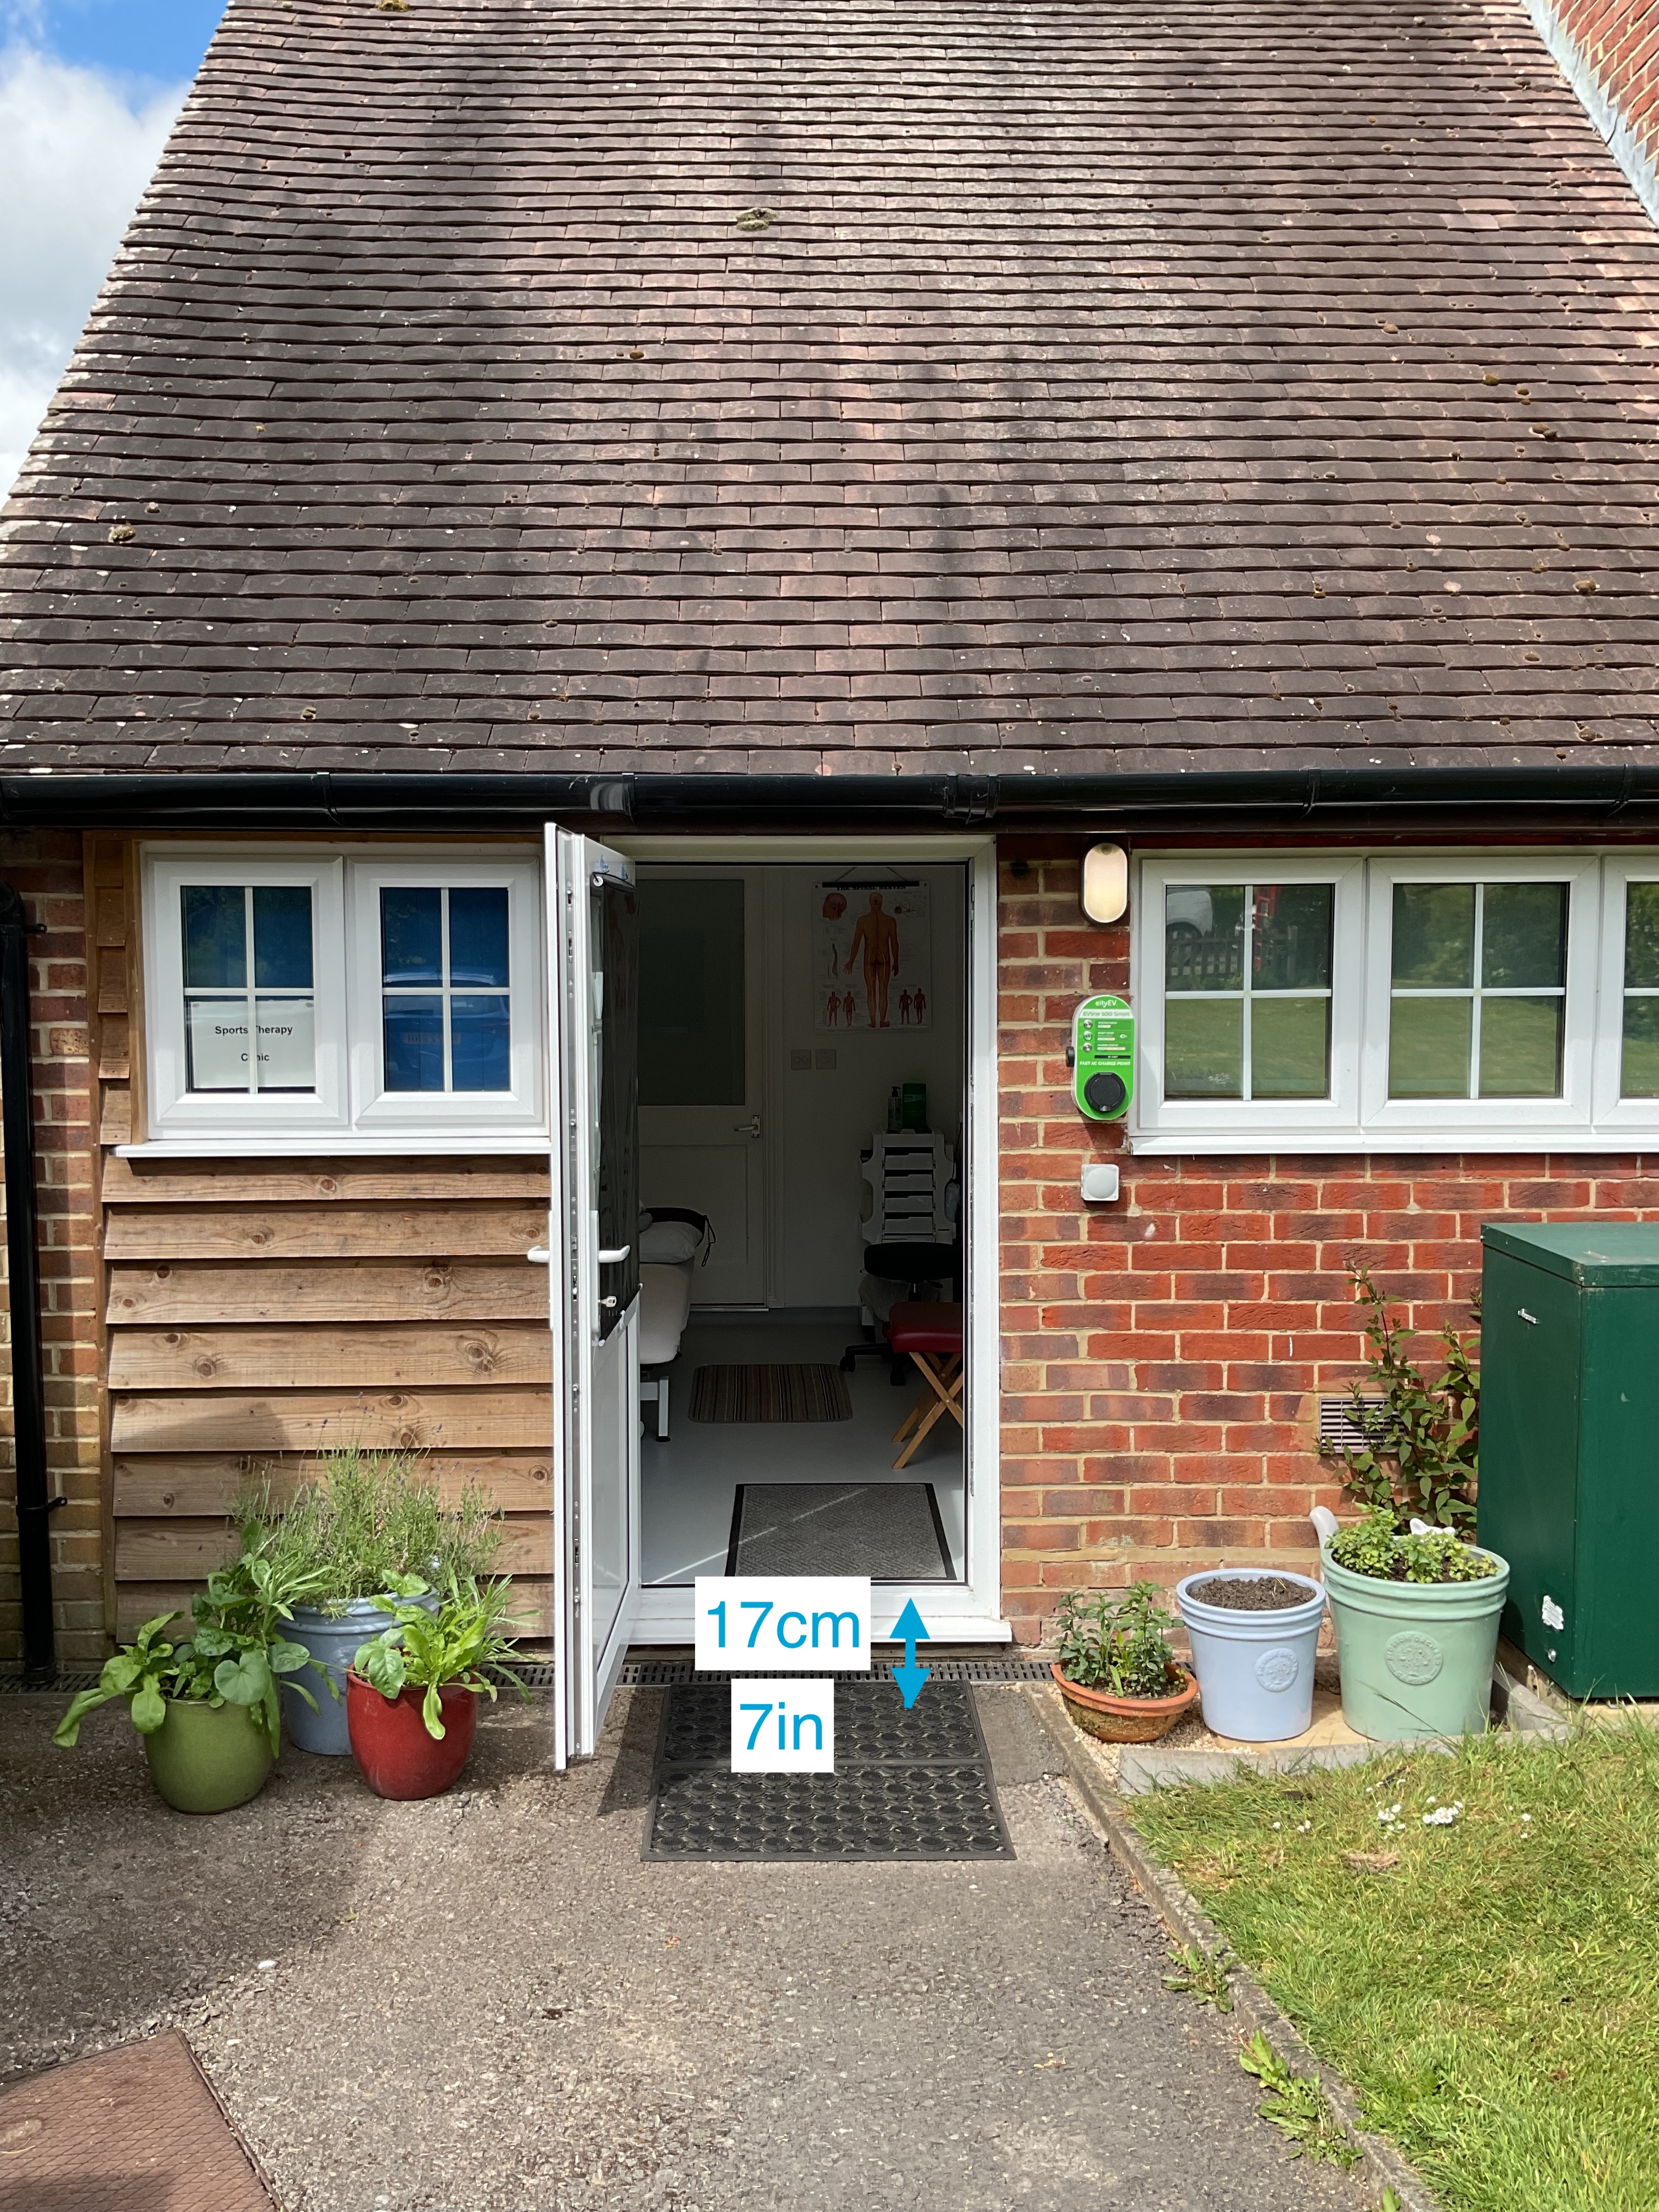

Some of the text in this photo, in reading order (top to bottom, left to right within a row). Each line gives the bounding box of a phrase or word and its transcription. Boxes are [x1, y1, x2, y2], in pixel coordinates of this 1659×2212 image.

[1095, 1000, 1117, 1008] cityEV
[215, 1025, 293, 1036] Sports herapy
[241, 1053, 270, 1062] Cnic
